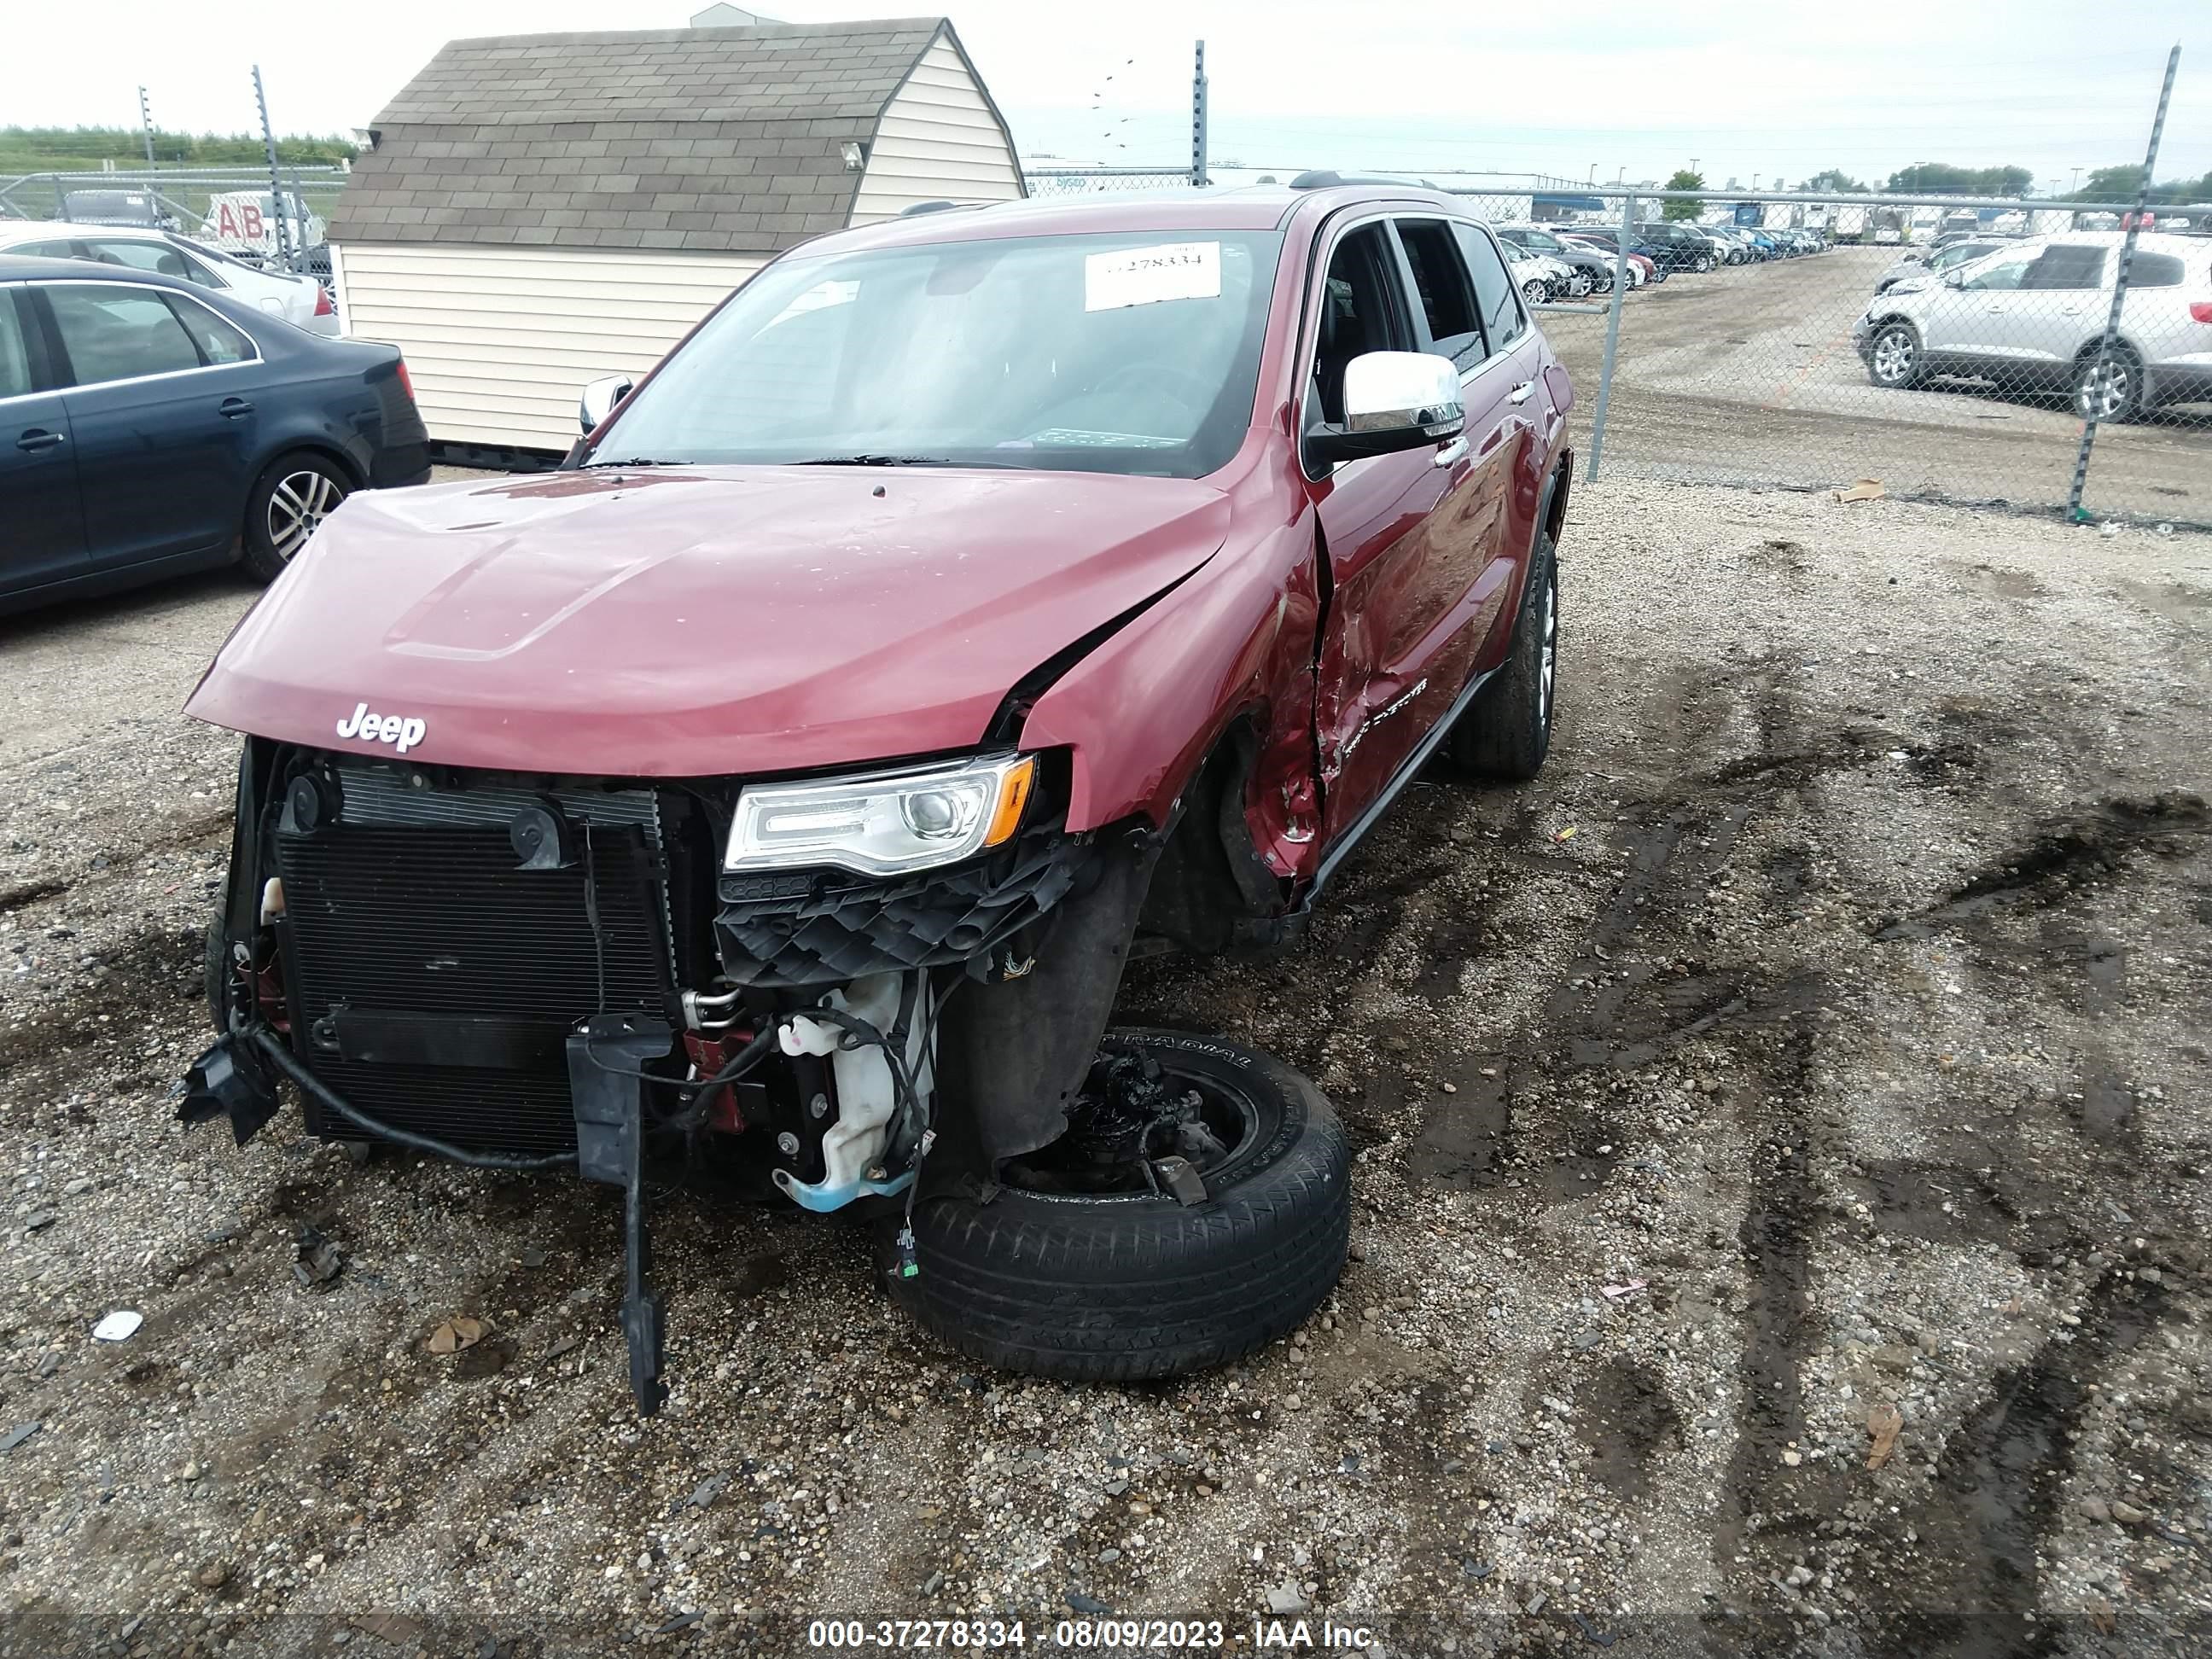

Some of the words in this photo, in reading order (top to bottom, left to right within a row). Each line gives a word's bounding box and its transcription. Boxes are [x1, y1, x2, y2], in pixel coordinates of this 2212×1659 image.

[1108, 255, 1202, 273] 278334
[336, 702, 427, 754] Jeep
[1123, 1034, 1251, 1068] RADIAL
